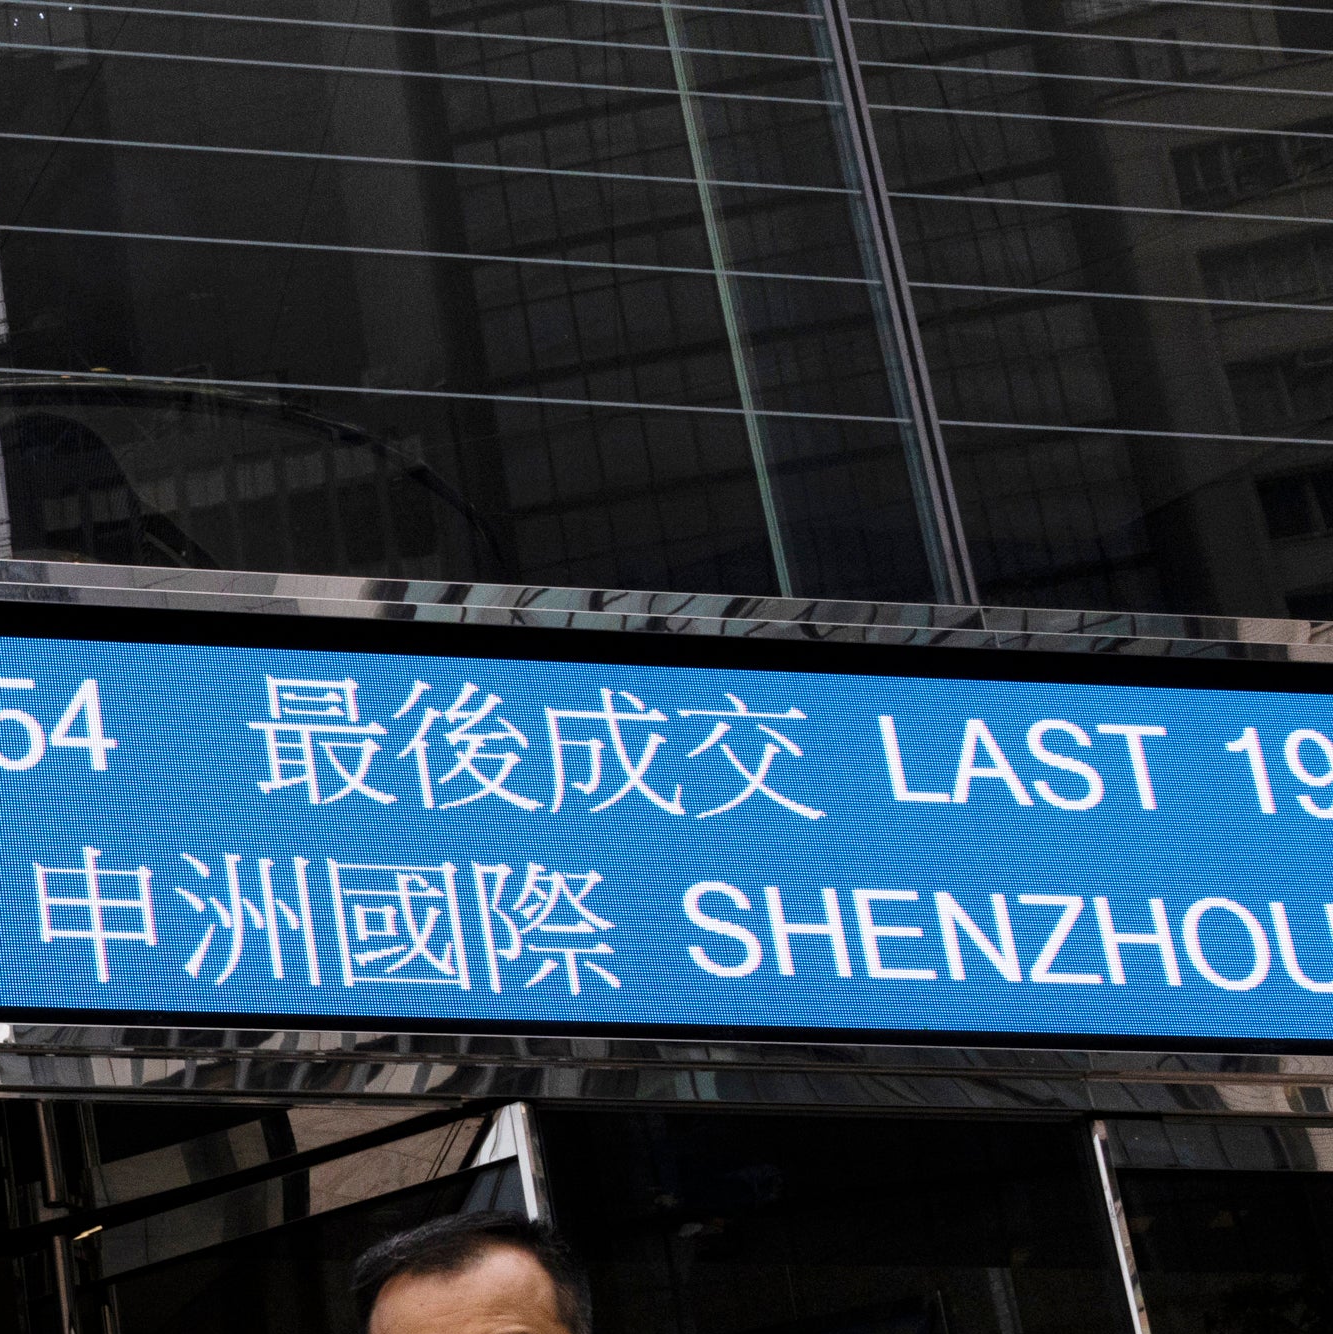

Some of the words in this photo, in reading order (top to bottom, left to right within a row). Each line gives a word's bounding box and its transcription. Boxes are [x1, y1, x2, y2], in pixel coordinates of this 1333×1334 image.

[247, 674, 827, 820] 最後成交
[878, 716, 1167, 811] LAST
[33, 845, 623, 996] 申洲國際
[682, 879, 1333, 993] SHENZHOU
